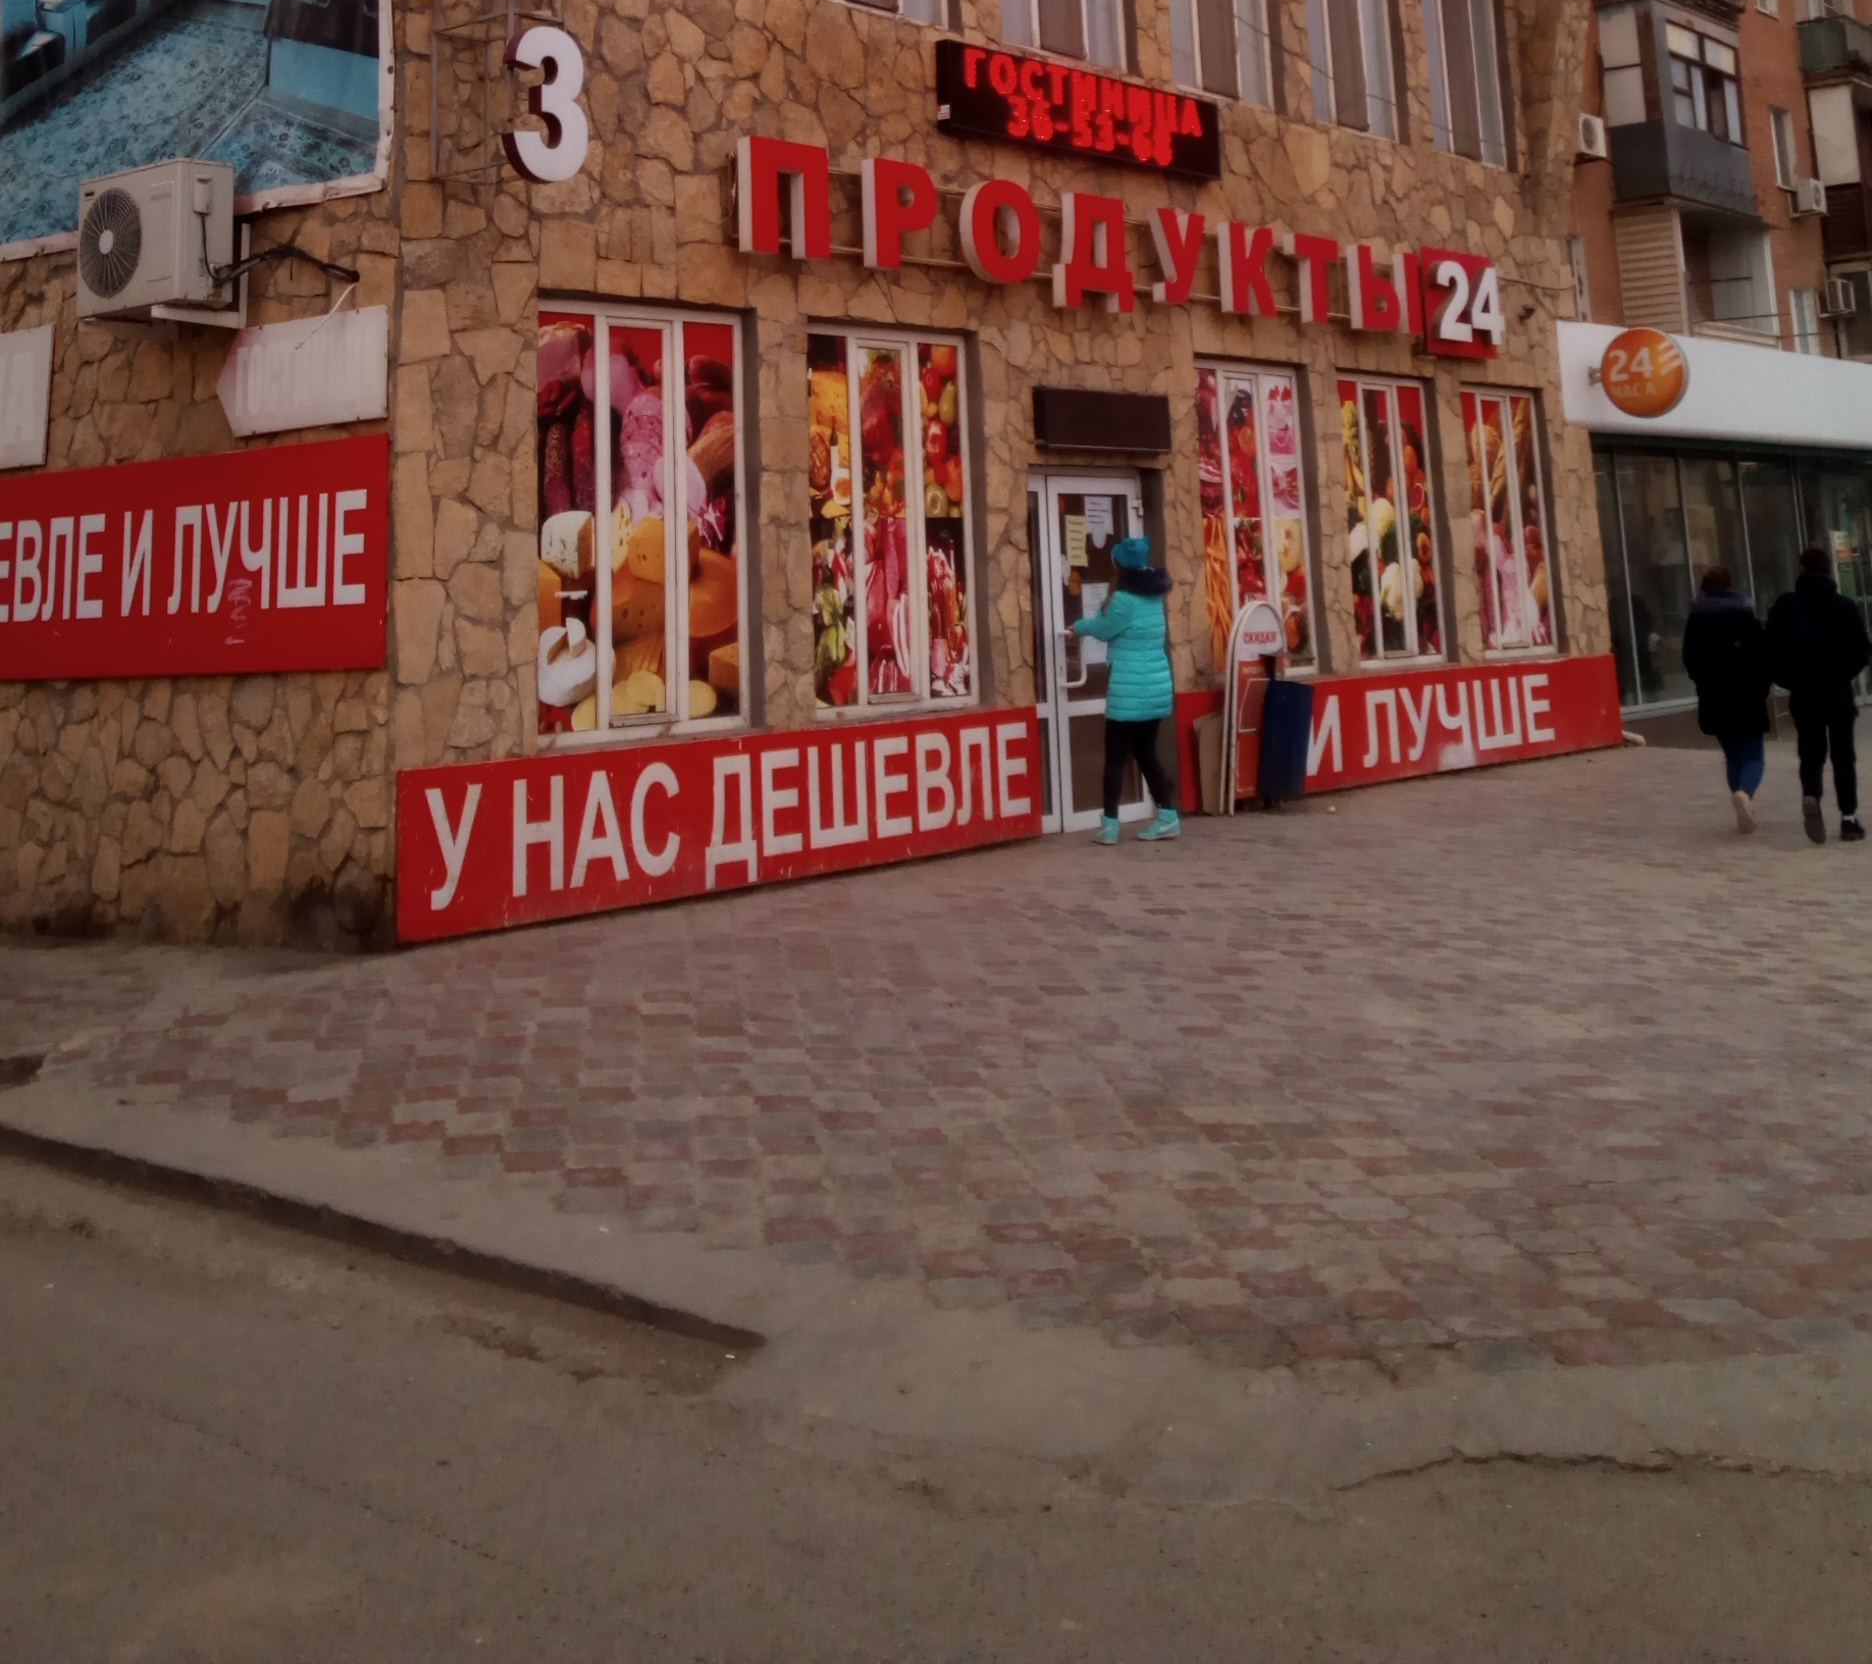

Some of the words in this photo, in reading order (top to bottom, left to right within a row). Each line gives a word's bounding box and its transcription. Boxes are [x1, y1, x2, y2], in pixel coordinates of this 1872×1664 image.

[964, 47, 1203, 137] ГОСТИНИЦА
[738, 135, 1424, 335] ПРОДУКТЫ
[1436, 259, 1506, 346] 24
[1608, 346, 1654, 382] 24
[121, 509, 154, 617] И
[167, 489, 368, 616] ЛУЧШЕ
[1306, 695, 1343, 776] И
[1363, 674, 1556, 769] ЛУЧШЕ
[425, 783, 483, 911] У
[512, 762, 680, 897] НАС
[705, 722, 1033, 890] ДЕШЕВЛЕ
